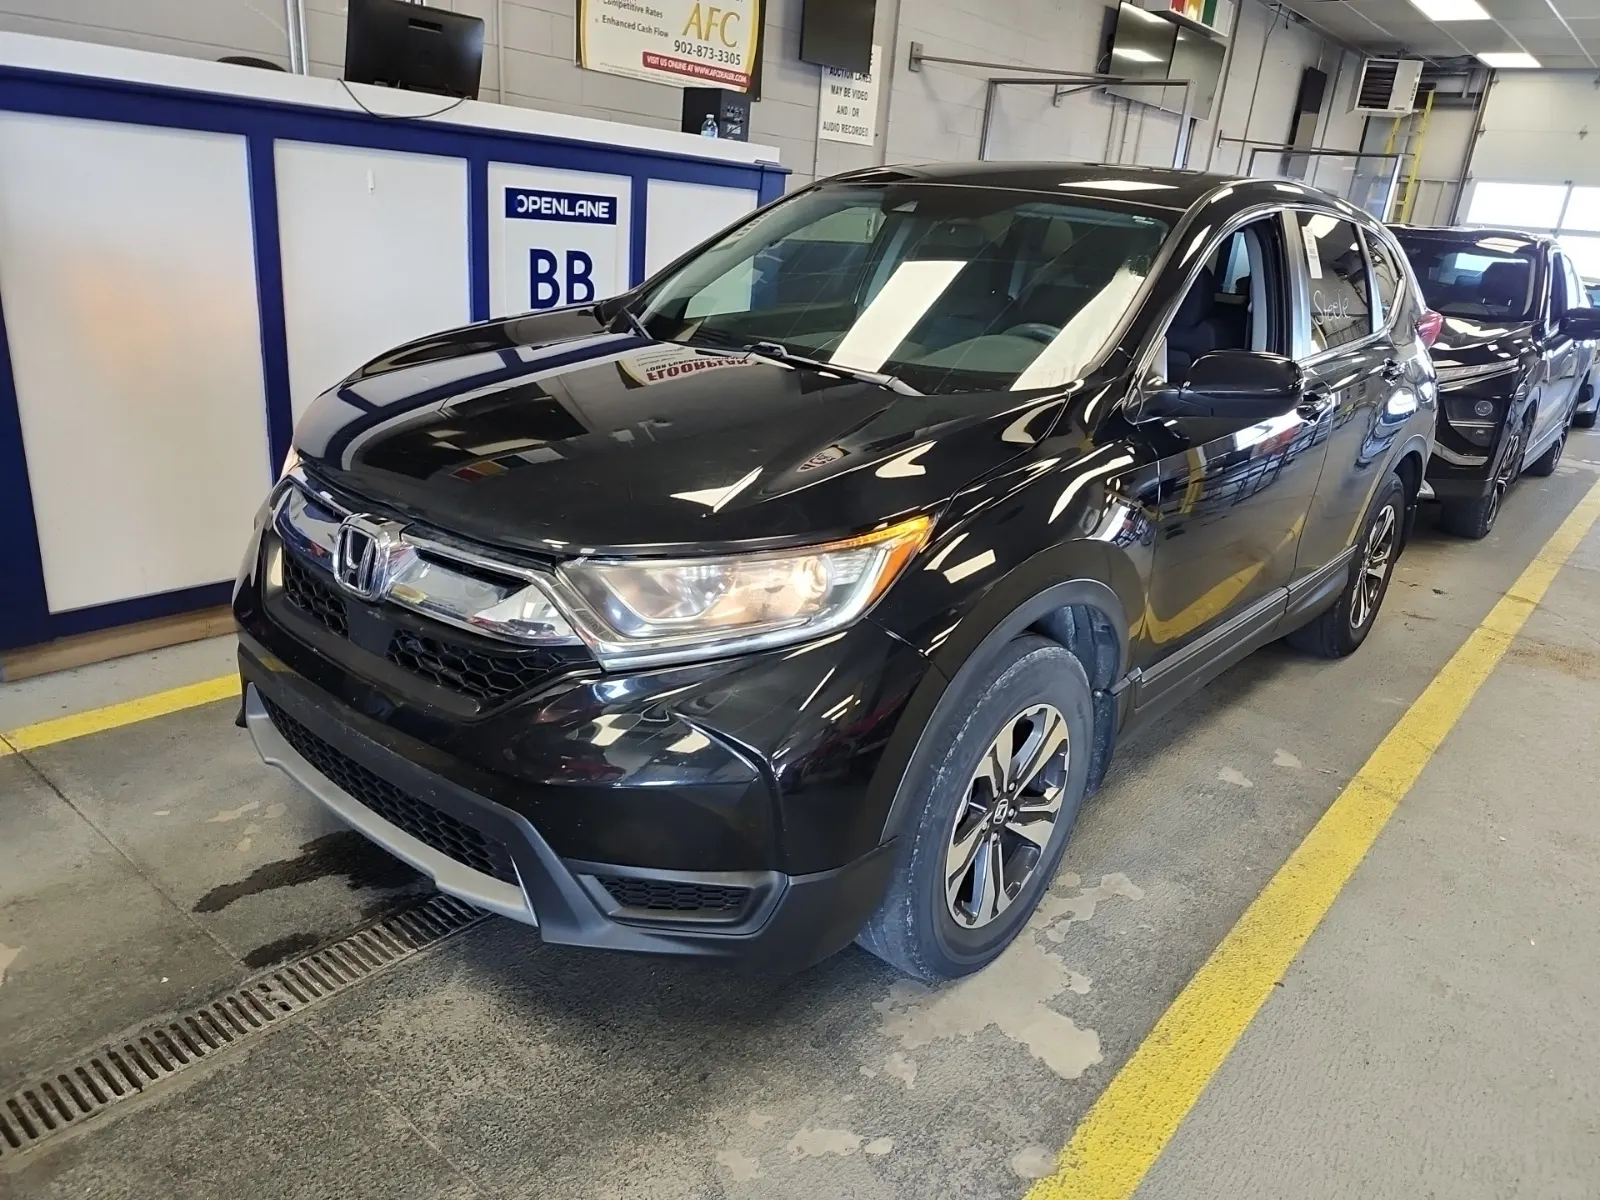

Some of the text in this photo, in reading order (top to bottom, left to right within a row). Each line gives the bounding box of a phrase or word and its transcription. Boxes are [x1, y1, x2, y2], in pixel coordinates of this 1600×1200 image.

[645, 6, 663, 18] Rates
[602, 14, 669, 38] Enhanced Cash Flow
[681, 2, 740, 48] AFC
[674, 39, 741, 65] 902-873-3305
[646, 54, 660, 65] VISIT
[660, 57, 668, 67] US
[668, 59, 688, 70] ONLINE
[688, 63, 694, 72] AT
[831, 84, 868, 101] MAY BE VIDEO
[836, 105, 848, 115] AND
[851, 107, 860, 118] OR
[822, 121, 869, 137] AUDIO RECORDED
[516, 194, 610, 219] OPENLANE
[529, 248, 596, 310] BB
